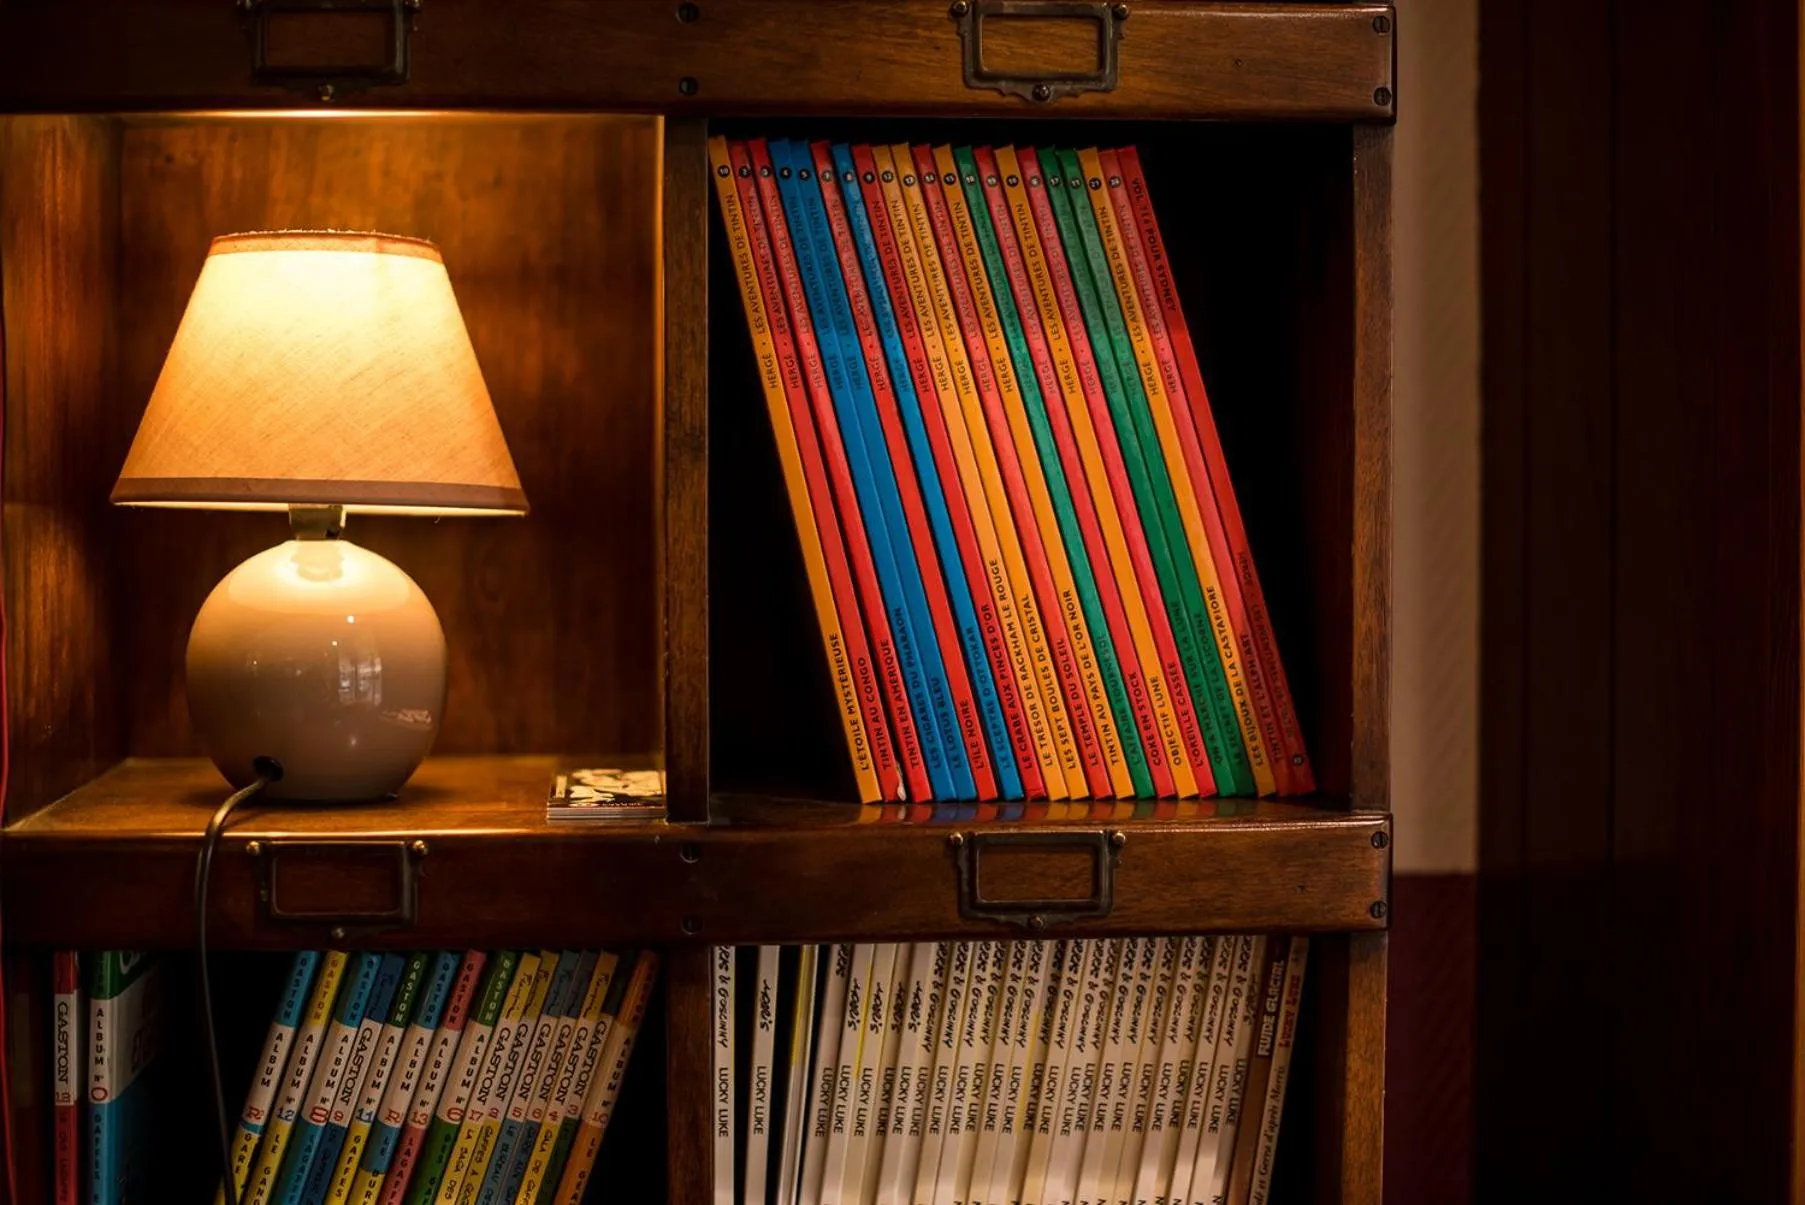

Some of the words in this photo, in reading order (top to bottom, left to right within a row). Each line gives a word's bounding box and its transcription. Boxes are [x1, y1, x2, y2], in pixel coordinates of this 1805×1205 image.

[726, 194, 740, 232] TINTIN
[890, 199, 906, 236] TINTIN
[912, 203, 928, 240] TINTIN
[953, 201, 968, 238] TINTIN
[1015, 203, 1032, 240] TINTIN
[1098, 205, 1114, 242] TINTIN
[734, 235, 745, 249] DE
[900, 240, 912, 253] DE
[923, 244, 933, 257] DE
[963, 241, 974, 255] DE
[1026, 243, 1037, 257] DE
[1109, 246, 1120, 260] DE
[739, 252, 760, 312] AVENTURES
[906, 257, 928, 316] AVENTURES
[1146, 228, 1161, 262] POUR
[1156, 265, 1176, 312] SYDNEY
[928, 260, 950, 320] AVENTURES
[969, 259, 992, 318] AVENTURES
[1032, 261, 1055, 320] AVENTURES
[1115, 263, 1137, 322] AVENTURES
[753, 316, 765, 333] LES
[923, 319, 934, 337] LES
[945, 323, 956, 340] LES
[987, 321, 998, 339] LES
[1049, 322, 1061, 340] LES
[1132, 325, 1143, 342] LES
[762, 353, 777, 388] HERGÉ
[932, 357, 948, 391] HERGÉ
[954, 360, 970, 394] HERGÉ
[996, 358, 1012, 392] HERGÉ
[1059, 359, 1075, 393] HERGÉ
[1142, 361, 1158, 395] HERGÉ
[989, 560, 1006, 600] ROUGE
[981, 604, 994, 633] D'OR
[1001, 604, 1011, 618] LE
[1022, 594, 1040, 642] CRISTAL
[1063, 590, 1077, 620] NOIR
[1206, 587, 1232, 658] CASTAFIORE
[1006, 622, 1028, 680] RACKHAM
[1035, 645, 1046, 661] DE
[1072, 623, 1086, 649] L'OR
[829, 634, 855, 714] MYSTÉRIEUSE
[990, 637, 1008, 679] PINCES
[1057, 638, 1072, 678] SOLEIL
[1081, 653, 1091, 668] DE
[1228, 662, 1238, 677] LA
[858, 657, 874, 701] CONGO
[1003, 683, 1015, 708] AUX
[1023, 684, 1034, 699] DE
[1040, 665, 1059, 712] BOULES
[1068, 682, 1079, 699] DU
[1086, 672, 1100, 700] PAYS
[1129, 671, 1146, 710] STOCK
[1150, 675, 1165, 707] LUNE
[1233, 681, 1244, 695] DE
[869, 706, 879, 722] AU
[896, 705, 907, 722] EN
[960, 701, 975, 737] NOIRE
[1074, 703, 1091, 748] TEMPLE
[1095, 703, 1106, 719] AU
[1140, 714, 1150, 730] EN
[1240, 699, 1256, 741] BIJOUX
[849, 719, 869, 770] L'ÉTOILE
[874, 727, 890, 769] TINTIN
[902, 726, 918, 767] TINTIN
[1010, 713, 1026, 751] CRABE
[1054, 717, 1069, 744] SEPT
[1101, 723, 1118, 764] TINTIN
[1160, 712, 1181, 765] OBJECTIF
[1181, 710, 1203, 766] L'OREILLE
[1022, 755, 1032, 769] LE
[1042, 753, 1053, 766] LE
[1063, 748, 1076, 769] LES
[1087, 752, 1098, 766] LE
[1146, 734, 1160, 765] COKE
[1251, 745, 1263, 765] LES
[395, 960, 421, 1022] GASTON
[57, 1002, 69, 1084] GASTON
[95, 1008, 104, 1065] ALBUM
[261, 1033, 283, 1088] ALBUM
[291, 1034, 314, 1089] ALBUM
[326, 1035, 349, 1089] ALBUM
[340, 1027, 373, 1105] GASTON
[371, 1036, 394, 1089] ALBUM
[477, 1027, 510, 1105] GASTON
[496, 1024, 528, 1103] GASTON
[519, 1024, 551, 1101] GASTON
[539, 1024, 571, 1103] GASTON
[555, 1027, 588, 1105] GASTON
[574, 1021, 607, 1099] GASTON
[718, 1067, 728, 1105] LUCKY
[755, 1066, 767, 1104] LUCKY
[835, 1065, 851, 1103] LUCKY
[935, 1066, 948, 1102] LUCKY
[956, 1066, 969, 1102] LUCKY
[1044, 1066, 1059, 1102] LUCKY
[718, 1109, 728, 1137] LUKE
[753, 1108, 765, 1134] LUKE
[833, 1104, 847, 1133] LUKE
[930, 1106, 943, 1134] LUKE
[950, 1105, 963, 1134] LUKE
[1038, 1105, 1051, 1134] LUKE
